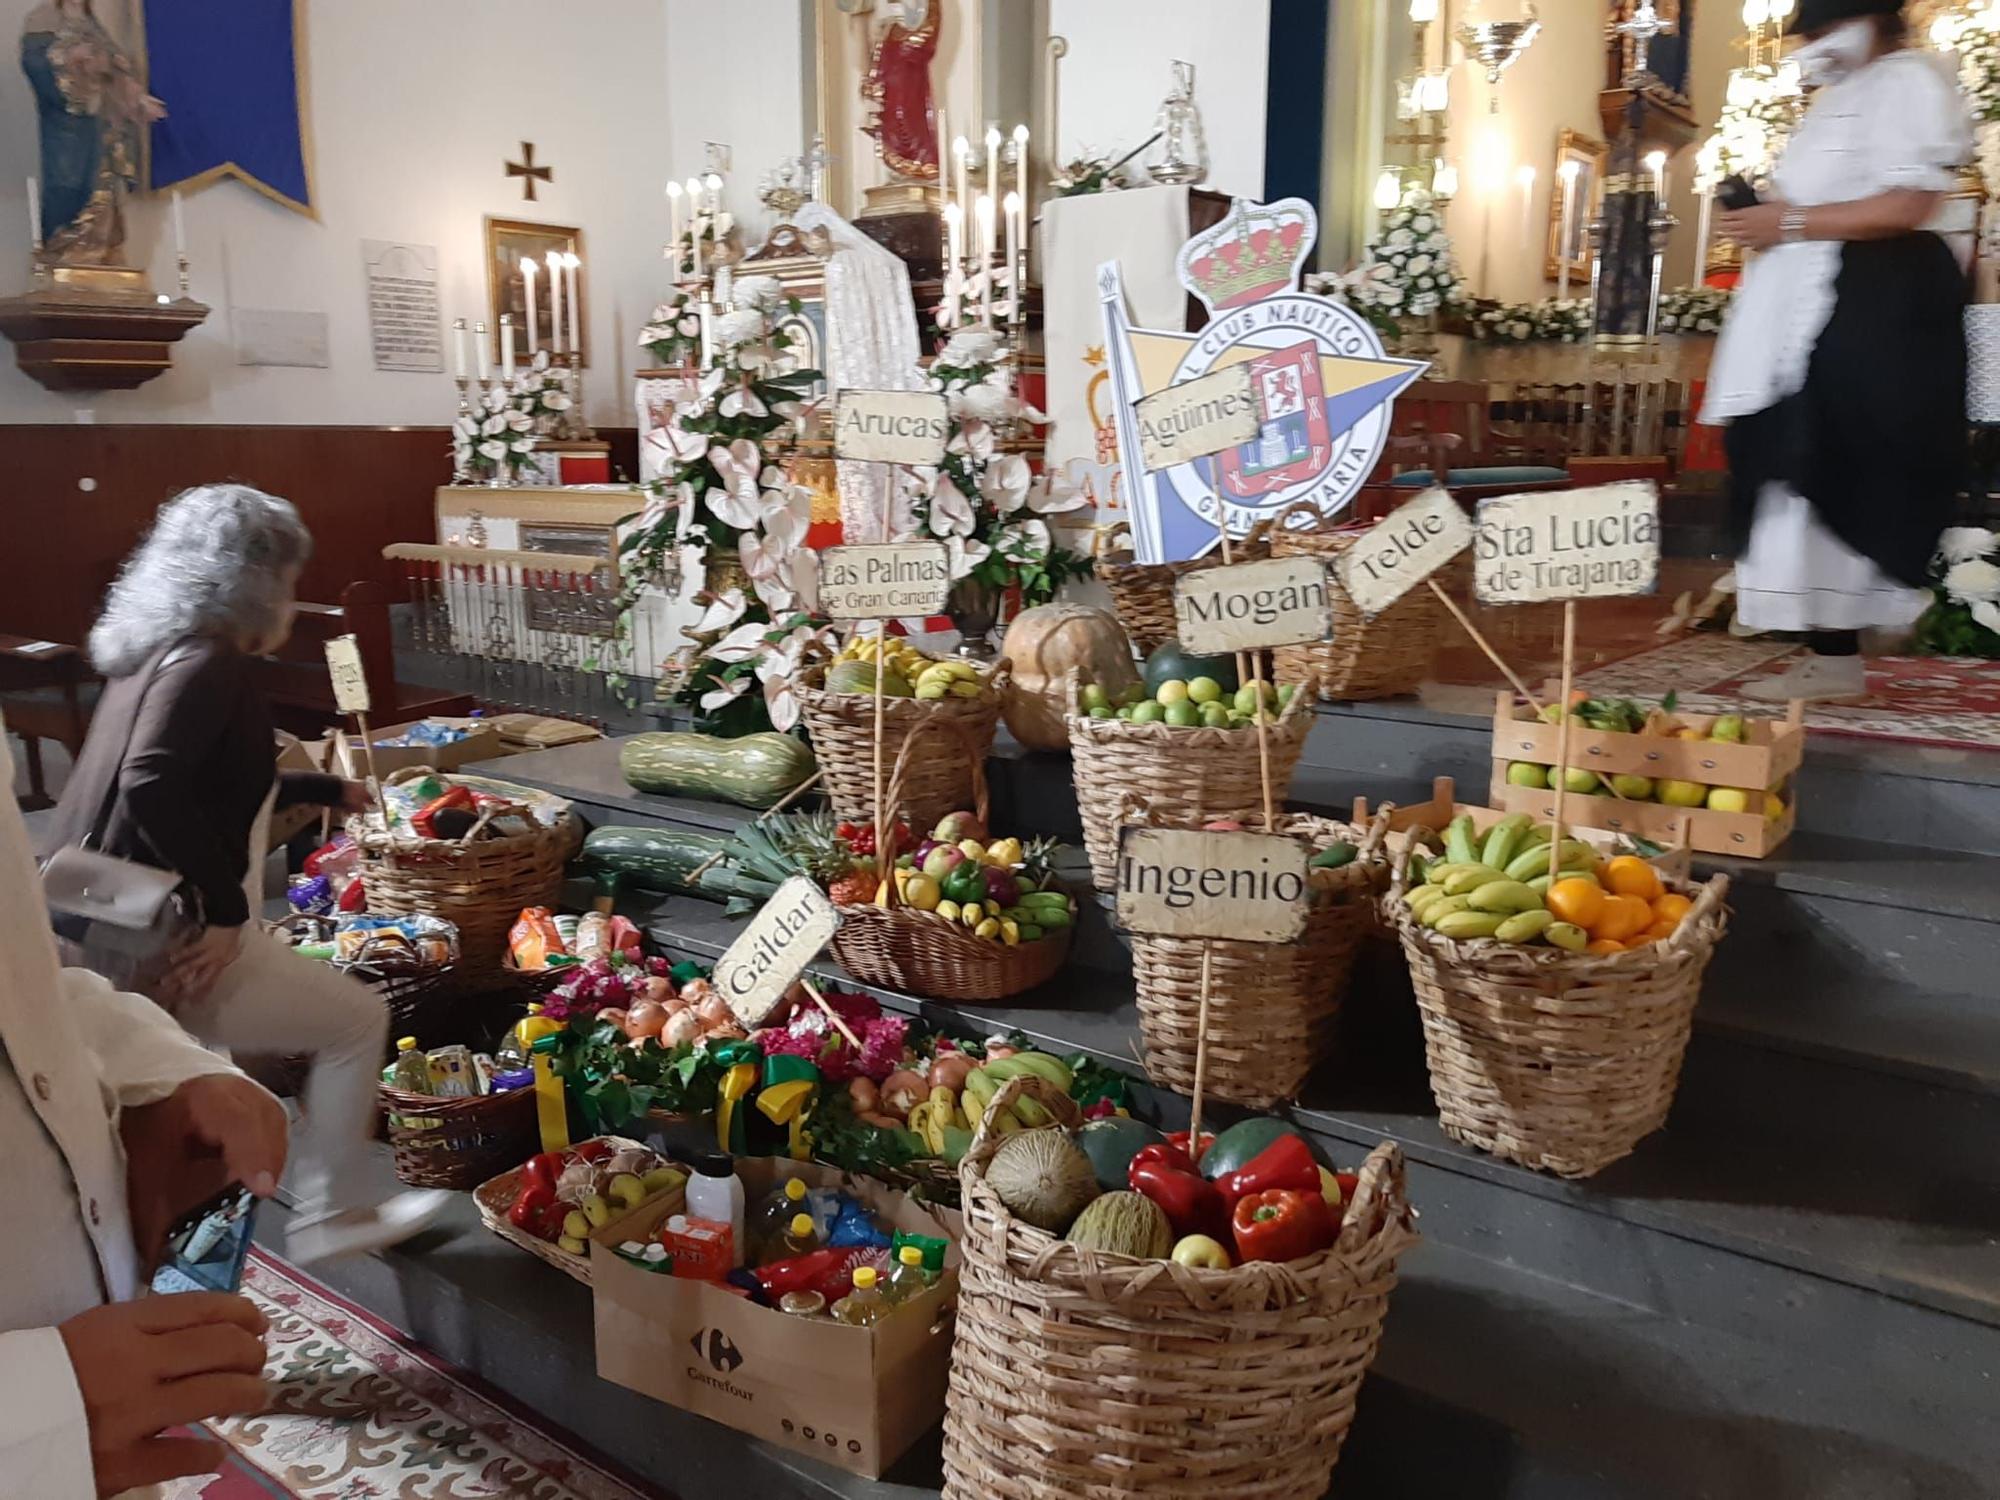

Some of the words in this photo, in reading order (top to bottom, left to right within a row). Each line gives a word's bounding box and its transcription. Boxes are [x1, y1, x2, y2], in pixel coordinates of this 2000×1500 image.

[1201, 312, 1256, 356] CLUB
[1266, 304, 1363, 355] NAUTICO
[845, 408, 945, 440] Arucas
[1140, 389, 1253, 448] Agüimes
[1360, 514, 1446, 580] Telde
[1480, 518, 1535, 560] Sta
[822, 563, 859, 586] Las
[866, 553, 946, 584] Palmas
[1489, 562, 1523, 592] de
[1529, 553, 1642, 594] Tirajana
[845, 592, 883, 609] Gran
[1185, 574, 1327, 625] Mogán
[1122, 857, 1304, 908] Ingenio
[730, 892, 814, 995] Gáldar
[687, 1366, 754, 1401] Carrefour
